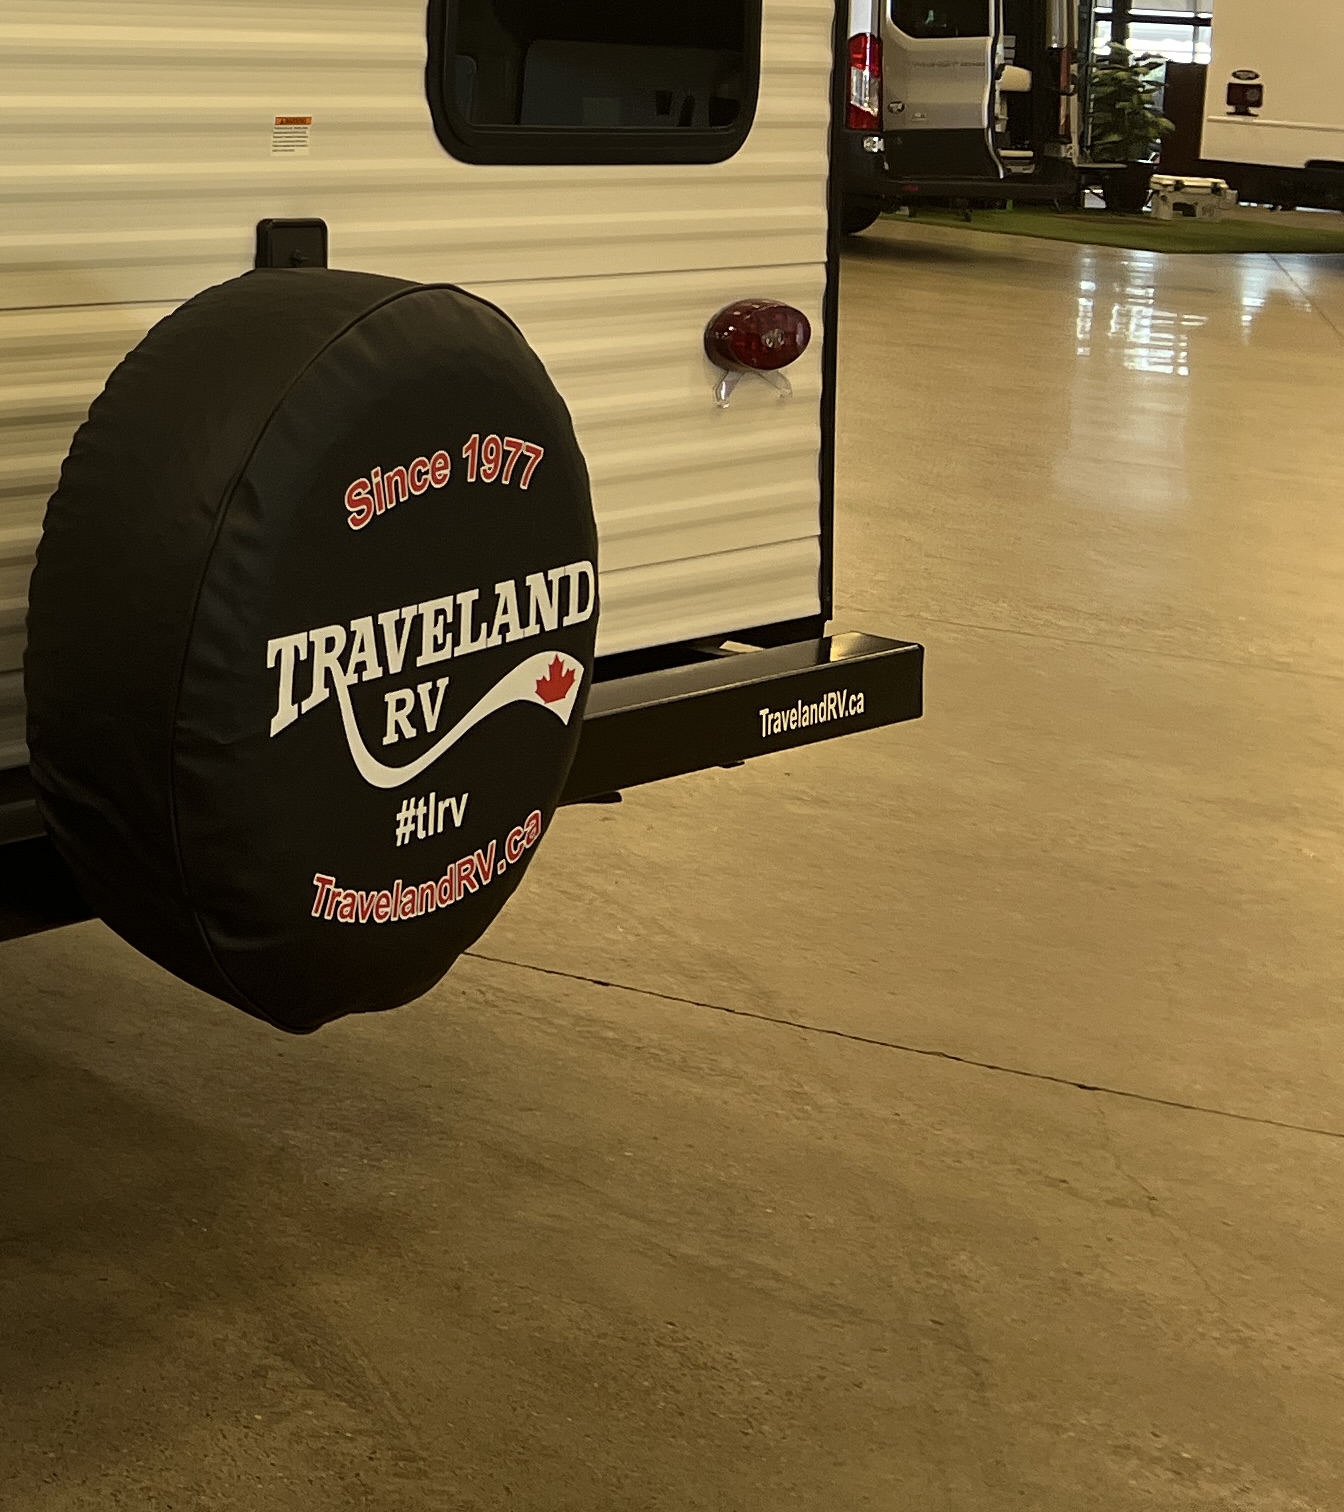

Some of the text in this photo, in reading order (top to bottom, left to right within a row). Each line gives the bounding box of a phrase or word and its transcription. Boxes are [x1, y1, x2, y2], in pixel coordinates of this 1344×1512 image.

[345, 434, 544, 530] Since 1977
[266, 560, 596, 738] TRAVELAND
[382, 677, 450, 746] RV
[759, 688, 865, 738] TravelandRV.ca
[395, 792, 469, 847] #tlrv
[311, 810, 542, 924] TravelandRV.ca
